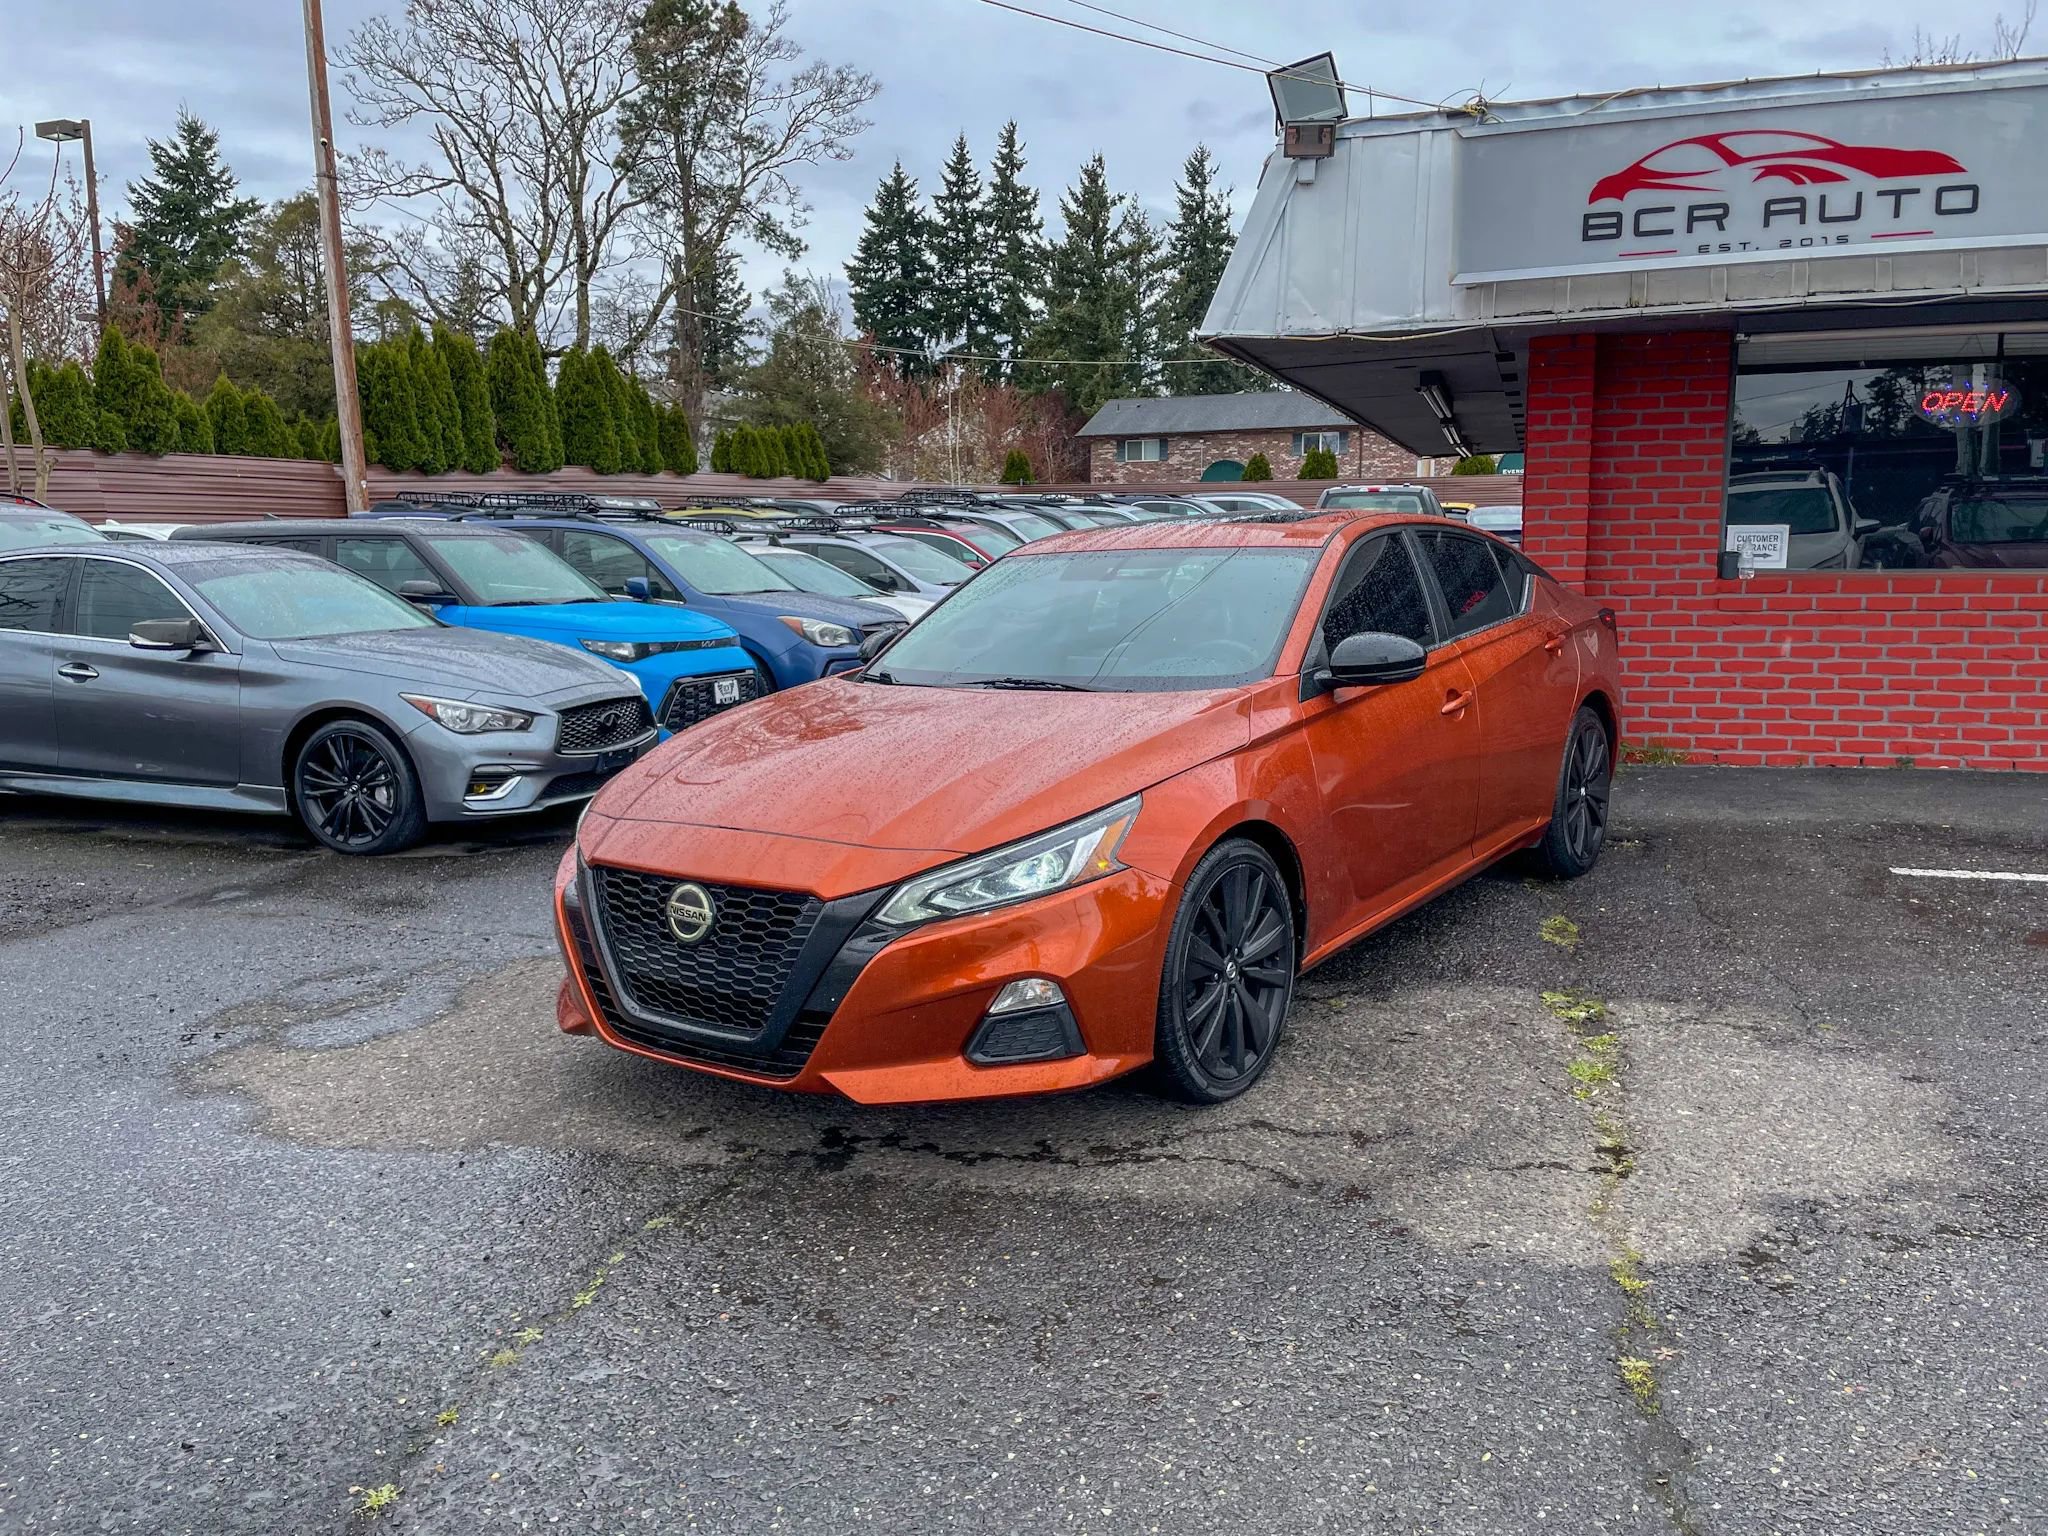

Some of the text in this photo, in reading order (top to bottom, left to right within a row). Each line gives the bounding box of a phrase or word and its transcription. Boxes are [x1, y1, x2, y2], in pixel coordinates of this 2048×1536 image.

[1582, 184, 1979, 242] BCR AUTO
[1698, 234, 1849, 254] EST. 2015
[1921, 391, 2009, 412] OPEN
[1736, 534, 1779, 543] CUSTOMER
[1736, 543, 1778, 552] ERANCE
[670, 905, 706, 922] NISSAN
